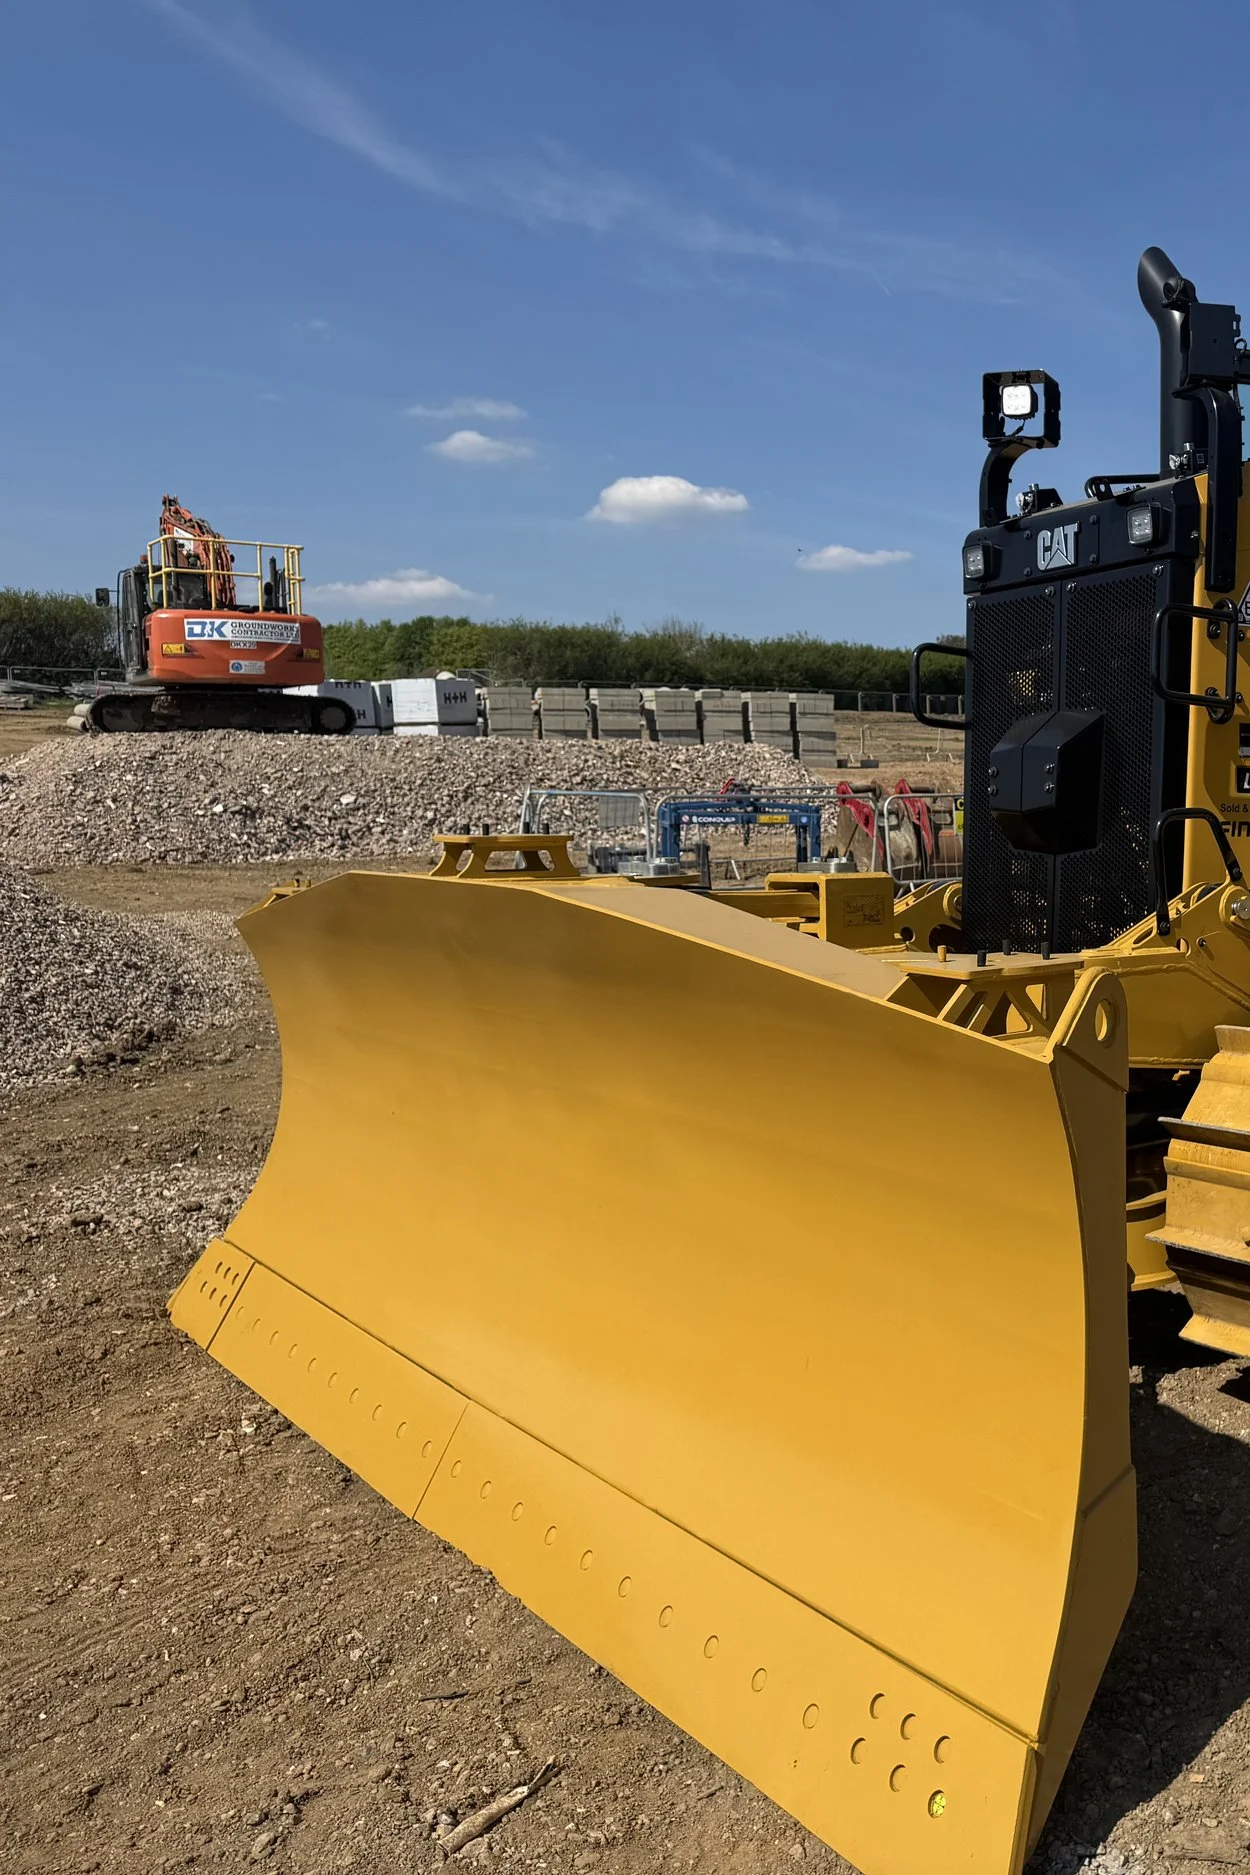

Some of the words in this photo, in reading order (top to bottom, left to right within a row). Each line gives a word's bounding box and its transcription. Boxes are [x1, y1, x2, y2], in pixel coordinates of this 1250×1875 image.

[1037, 521, 1079, 570] CAT
[230, 629, 284, 638] CONTRACTOR
[443, 691, 467, 705] H+H
[1220, 803, 1239, 813] Sold
[1242, 804, 1249, 813] &
